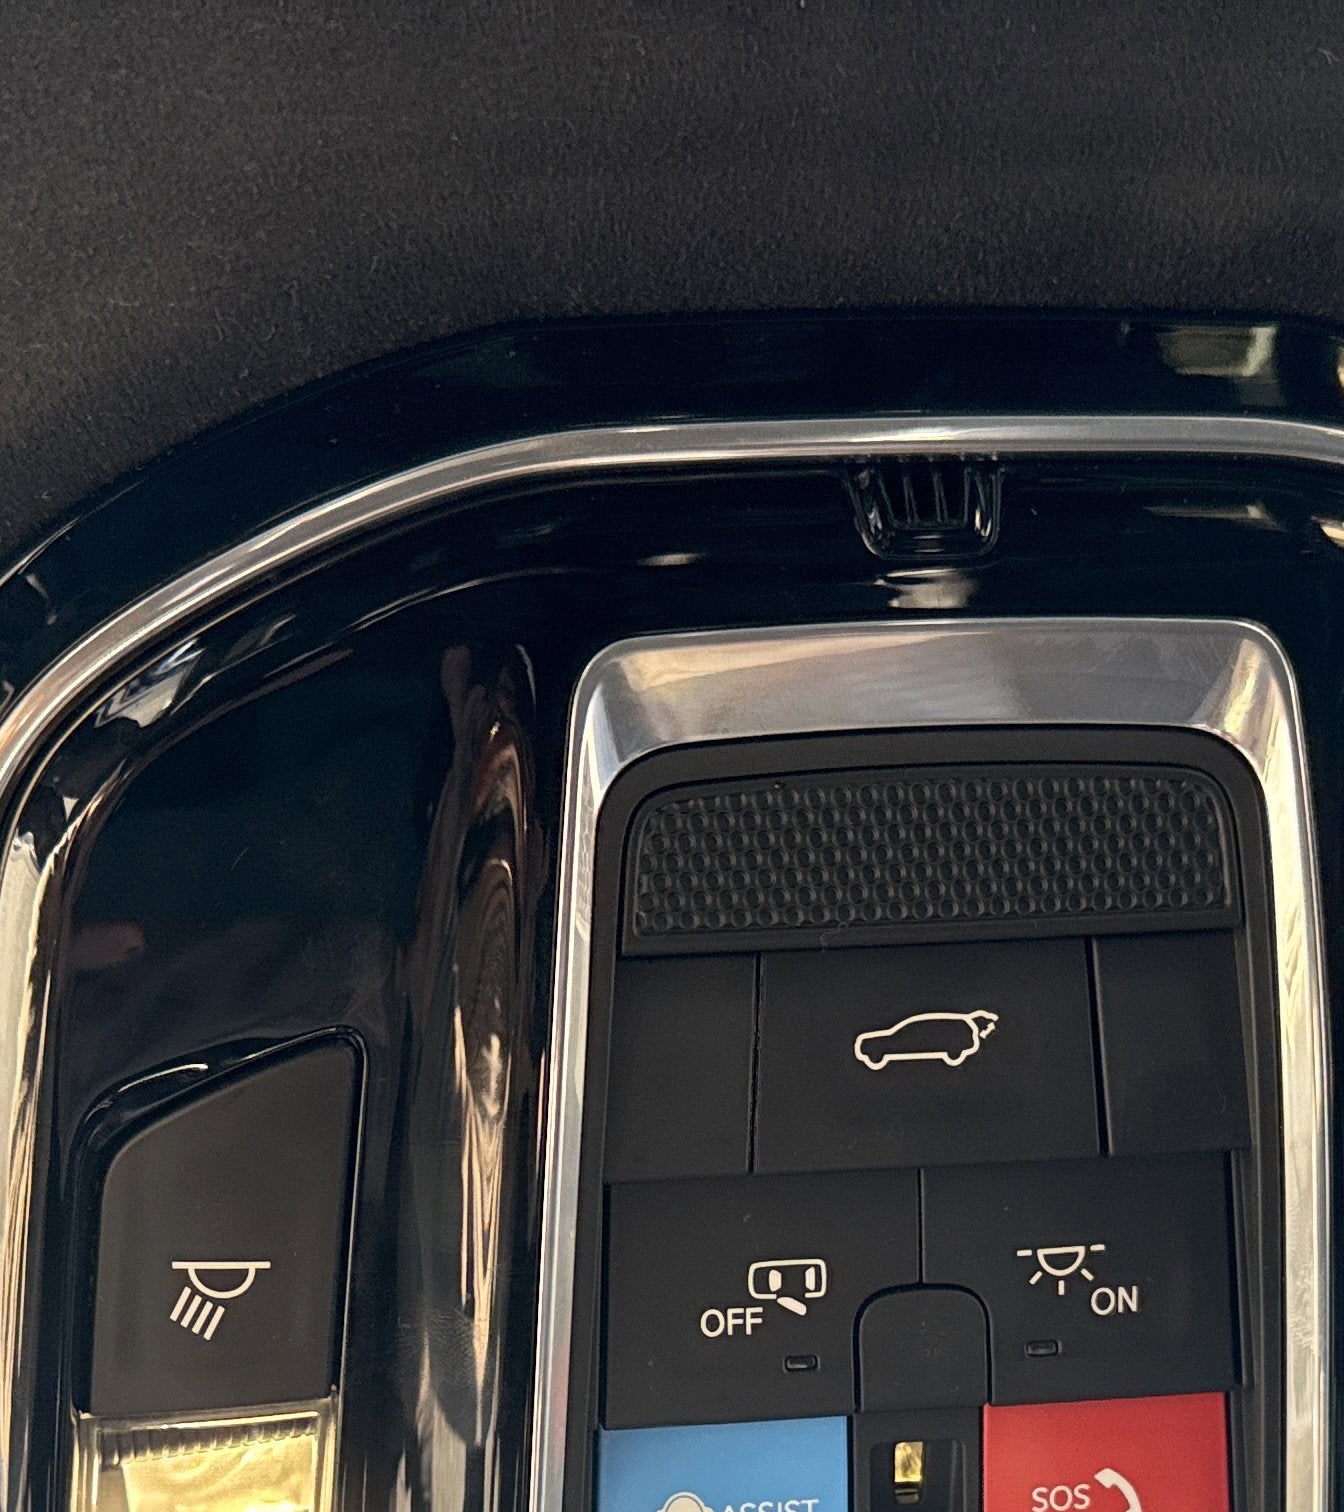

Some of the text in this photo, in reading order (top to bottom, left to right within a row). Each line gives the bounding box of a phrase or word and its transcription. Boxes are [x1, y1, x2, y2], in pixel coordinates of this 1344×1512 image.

[1090, 1286, 1138, 1316] ON
[700, 1307, 763, 1338] OFF
[1031, 1483, 1091, 1512] SOS
